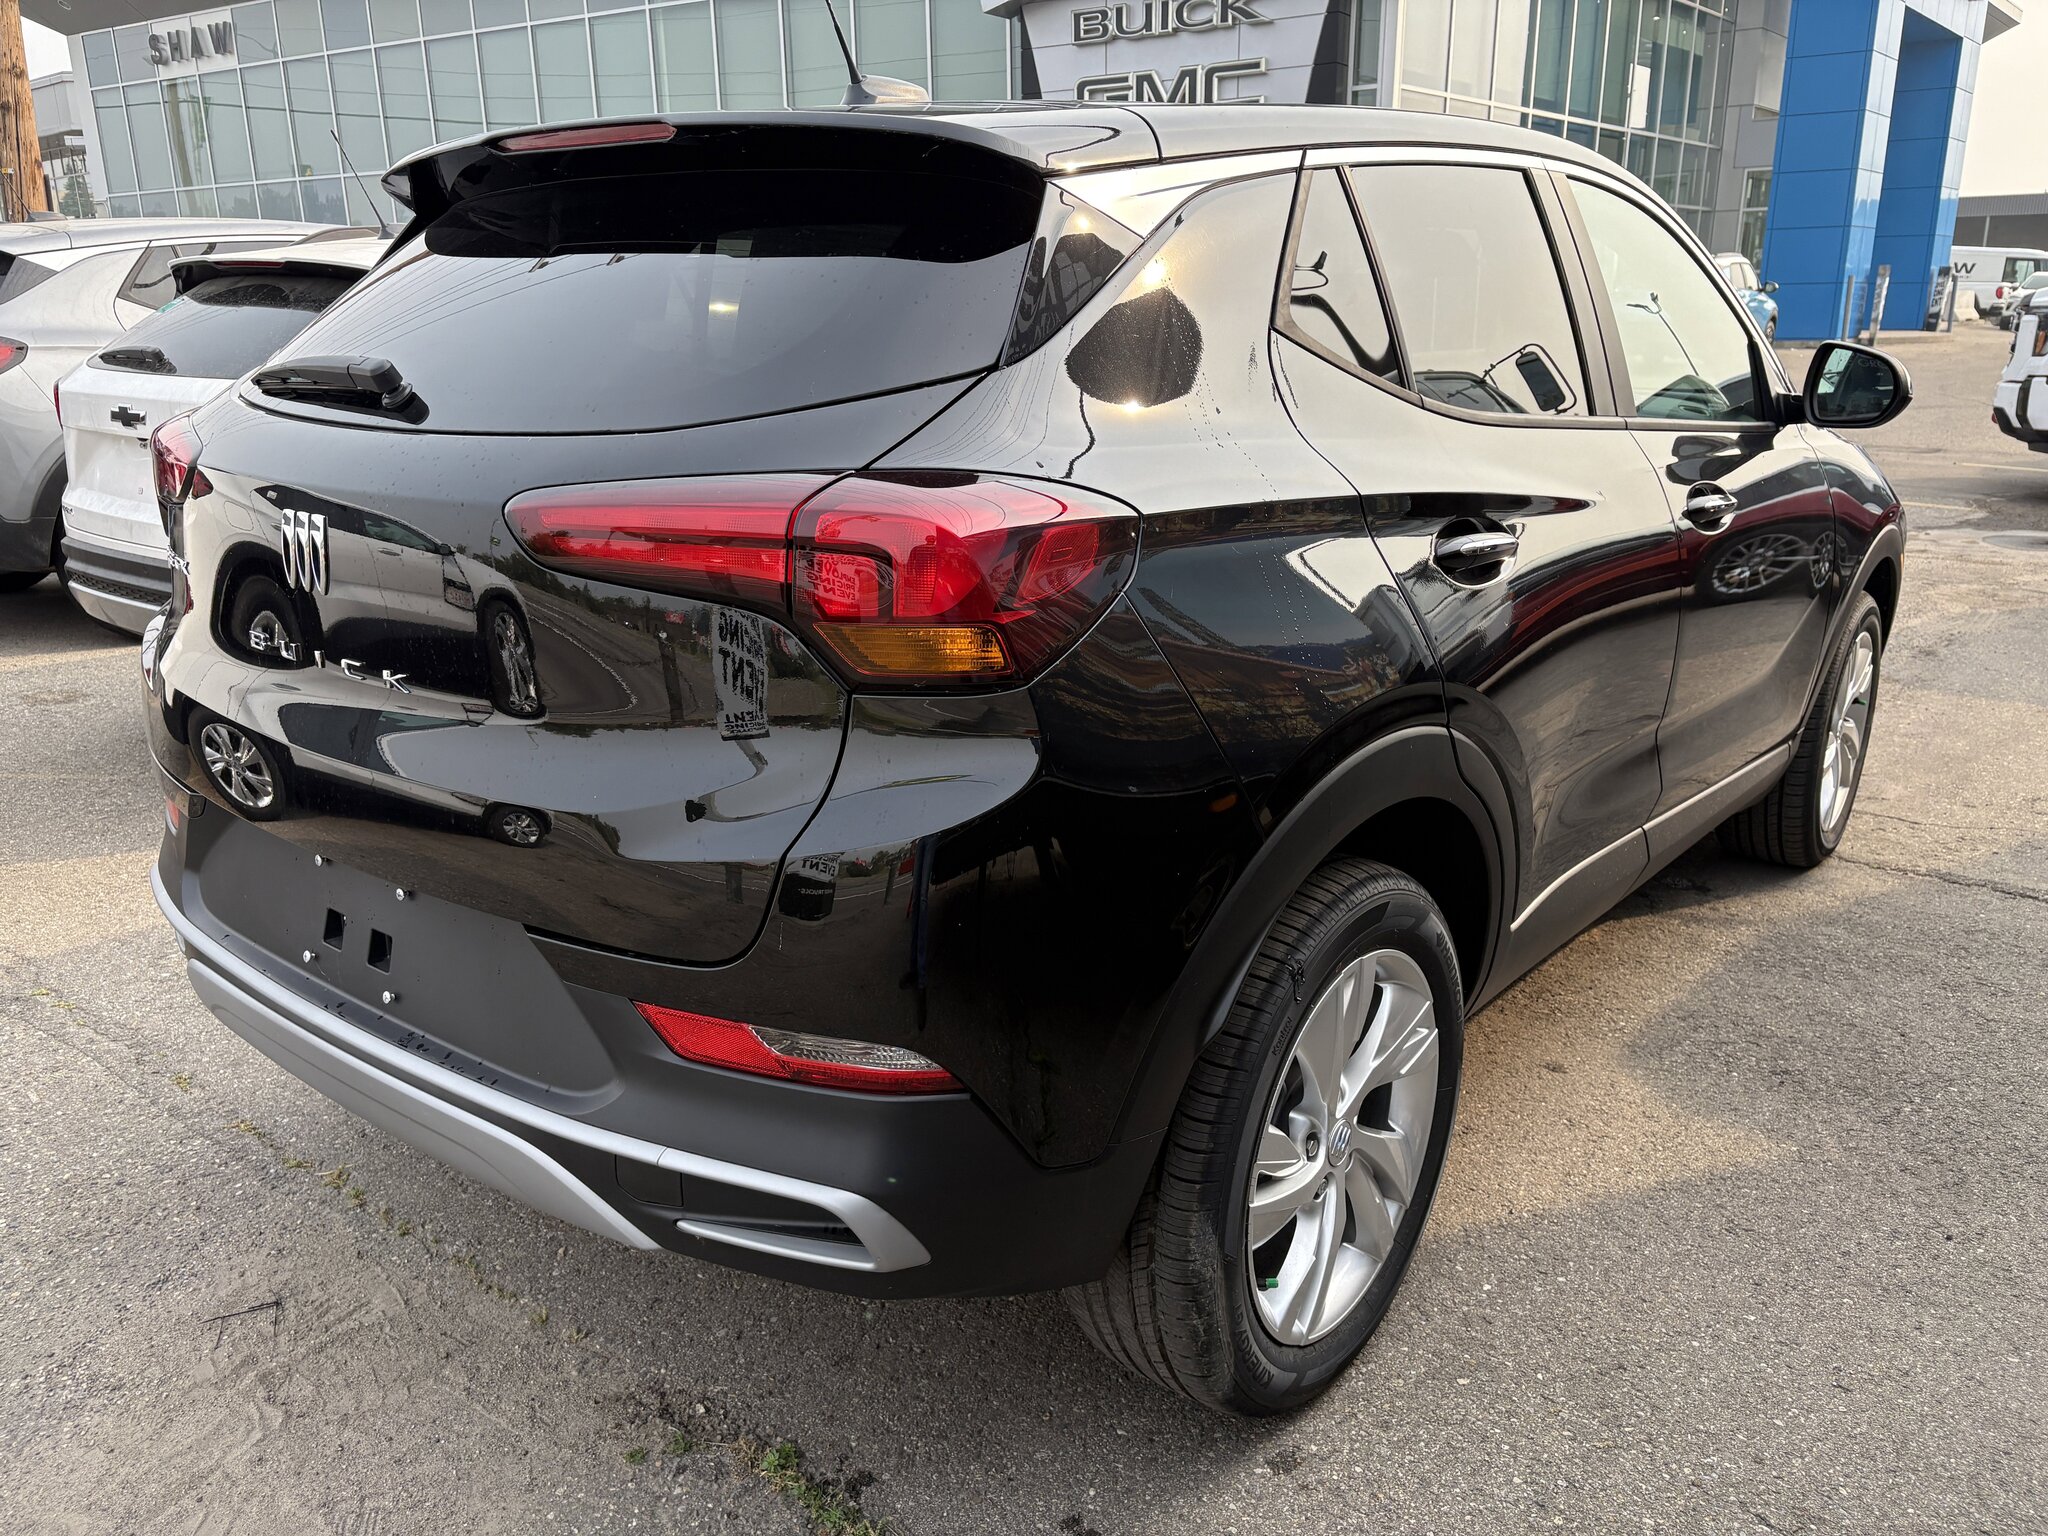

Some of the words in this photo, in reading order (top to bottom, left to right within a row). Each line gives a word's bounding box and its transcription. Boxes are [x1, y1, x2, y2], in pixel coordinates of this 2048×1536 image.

[148, 21, 234, 65] SHAW
[1072, 0, 1274, 46] BUICK
[1074, 57, 1266, 103] GMC
[249, 630, 412, 694] BUICK
